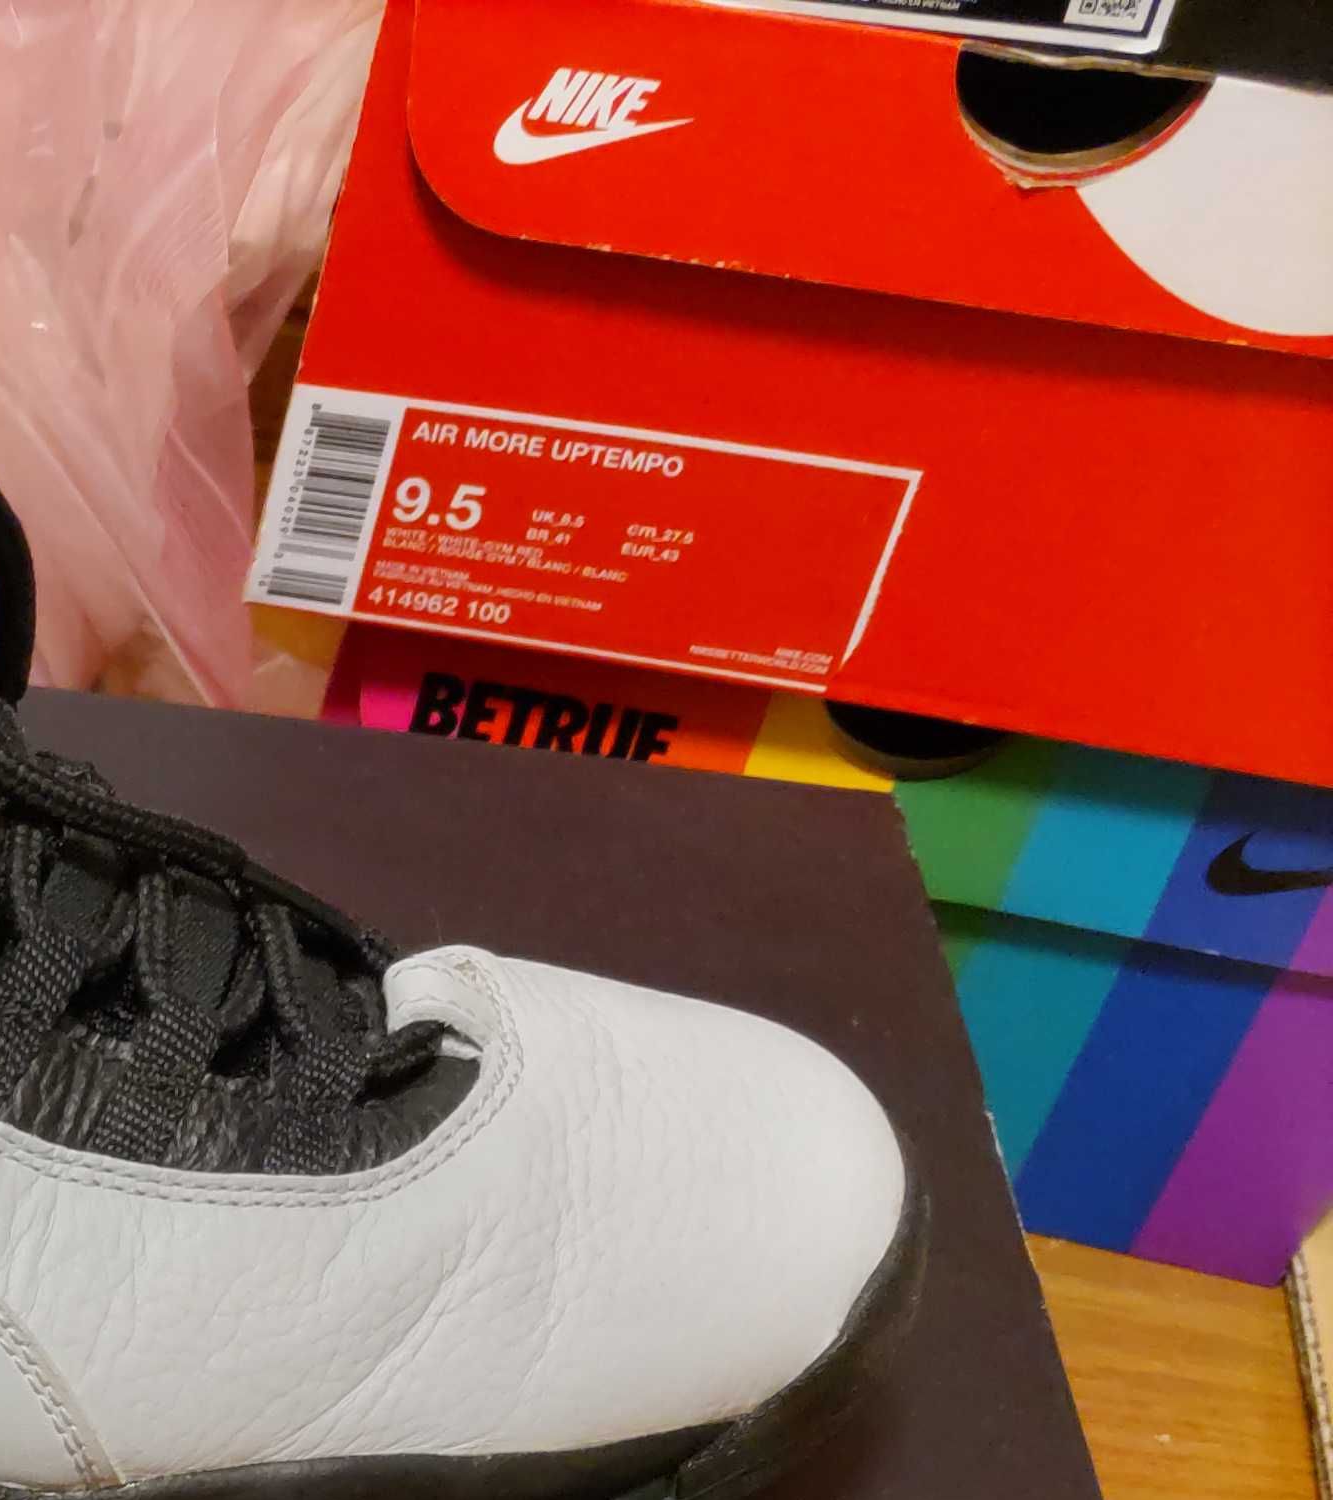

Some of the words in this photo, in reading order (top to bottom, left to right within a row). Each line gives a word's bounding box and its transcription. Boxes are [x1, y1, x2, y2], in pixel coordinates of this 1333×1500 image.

[527, 67, 661, 130] NIKE
[412, 421, 459, 445] AIR
[464, 427, 546, 457] MORE
[550, 439, 684, 477] UPTEMPO
[393, 476, 486, 531] 9.5
[368, 585, 459, 617] 414962
[467, 599, 511, 624] 100
